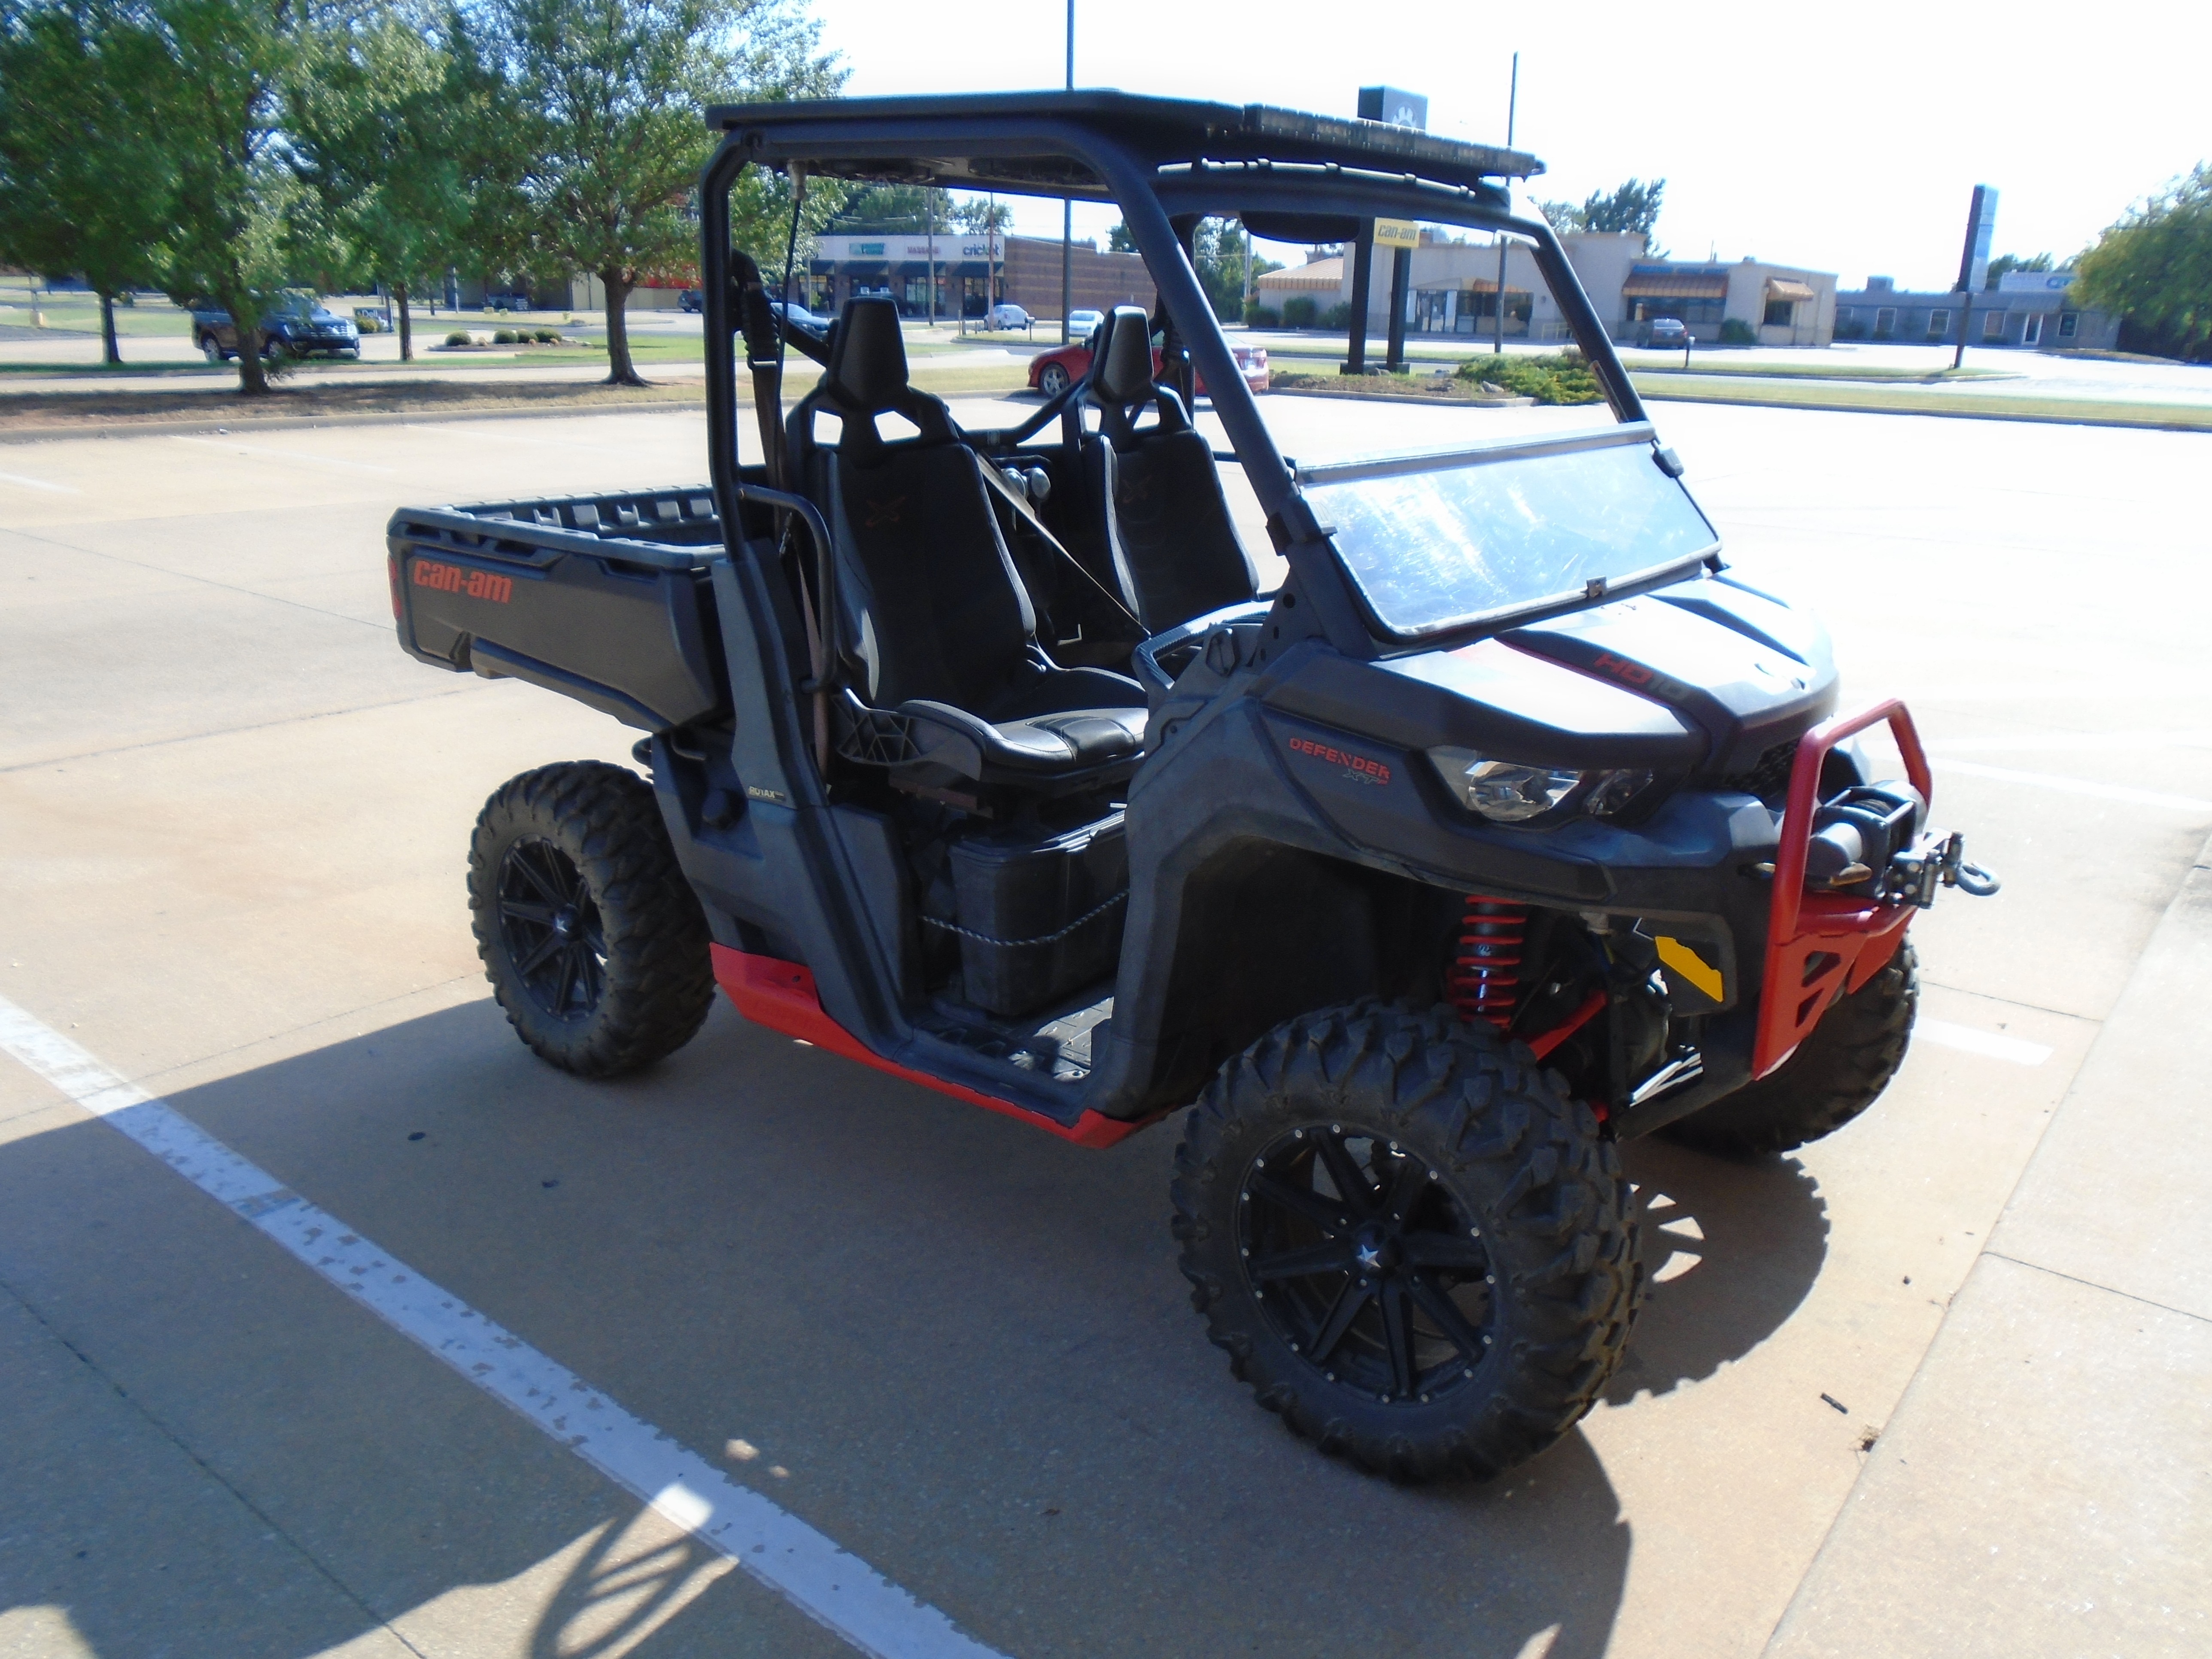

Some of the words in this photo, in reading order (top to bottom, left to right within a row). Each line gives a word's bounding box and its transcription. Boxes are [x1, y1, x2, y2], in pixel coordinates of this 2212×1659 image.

[1378, 225, 1416, 240] can-am
[963, 243, 1000, 256] crickt
[414, 560, 512, 604] can-am
[1290, 738, 1390, 779] DEFENDER
